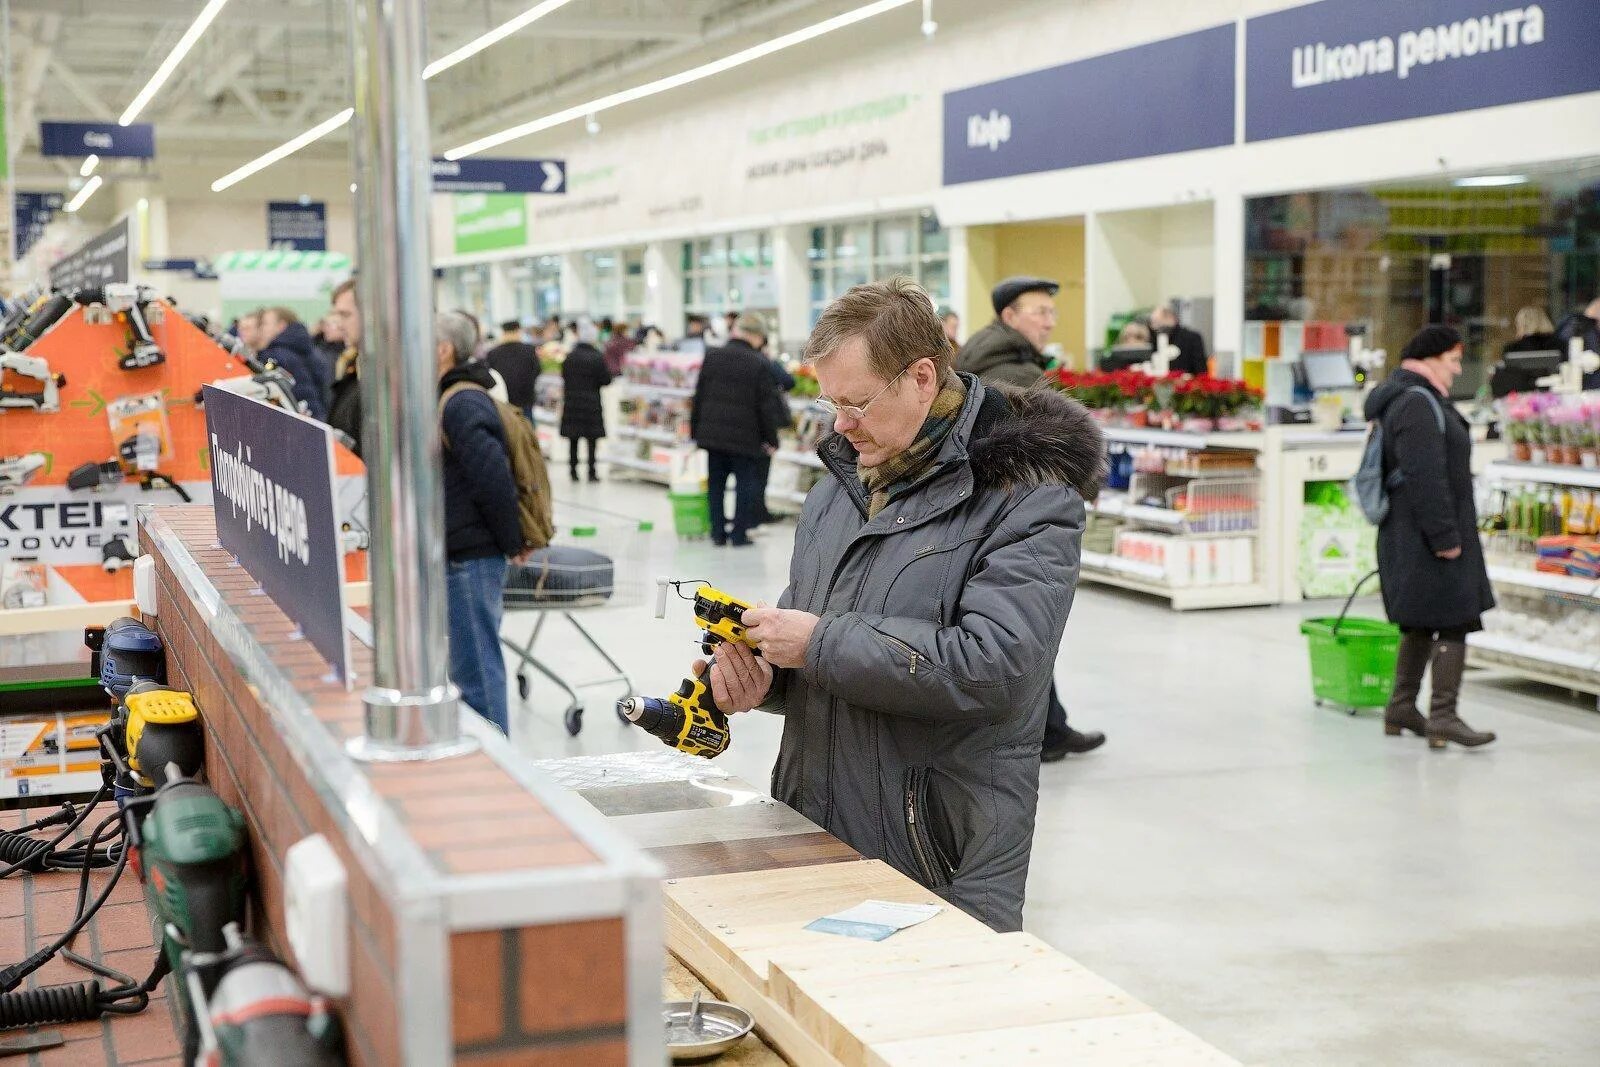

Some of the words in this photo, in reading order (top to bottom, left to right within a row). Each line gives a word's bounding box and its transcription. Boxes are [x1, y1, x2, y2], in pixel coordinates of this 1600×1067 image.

[1292, 36, 1395, 89] Школа
[1397, 4, 1546, 79] ремонта
[967, 108, 1012, 152] Кафе
[1309, 454, 1328, 472] 16
[211, 432, 268, 532] Попробуйте
[265, 477, 277, 537] в
[274, 483, 310, 567] деле
